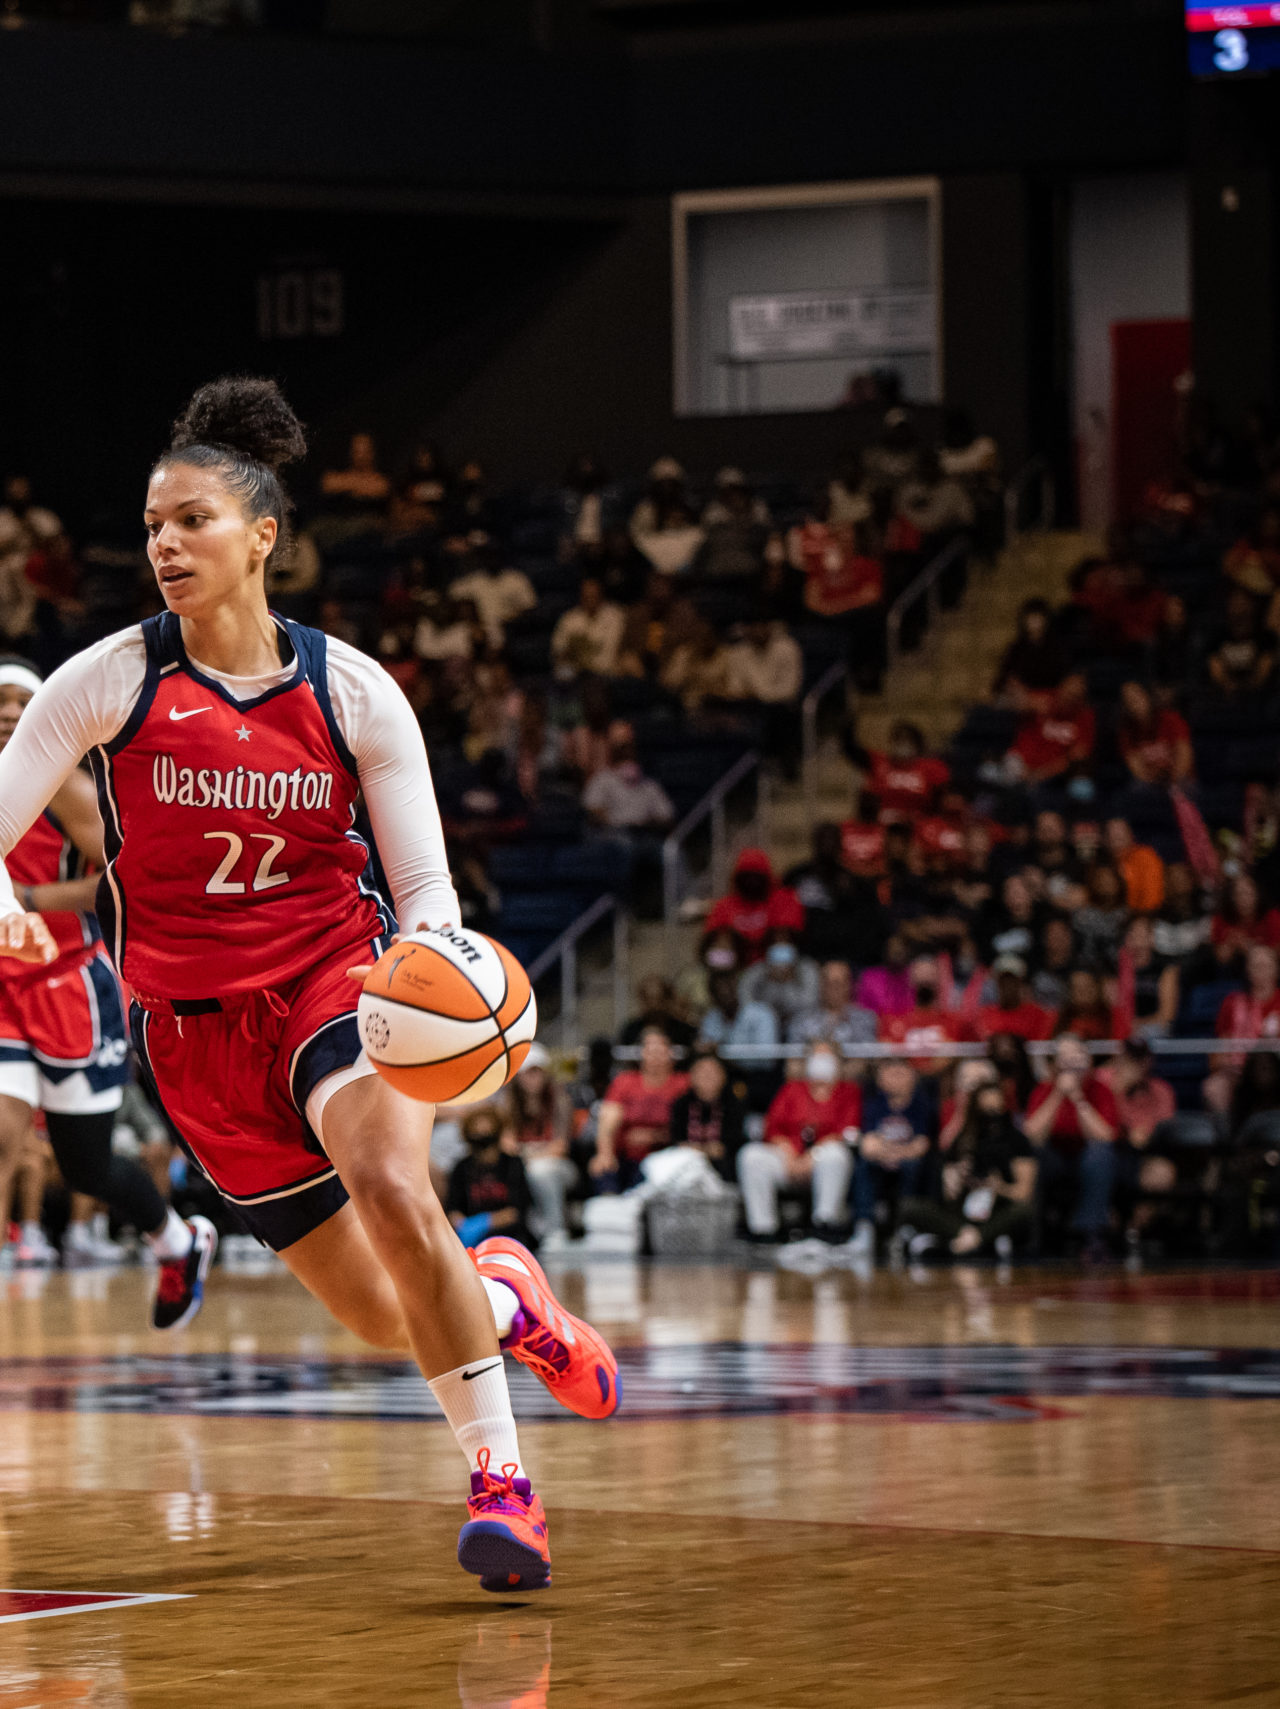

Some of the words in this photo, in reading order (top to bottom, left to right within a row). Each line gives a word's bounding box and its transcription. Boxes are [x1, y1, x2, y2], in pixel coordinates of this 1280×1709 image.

[1213, 28, 1249, 72] 3
[258, 272, 343, 338] 109
[152, 752, 334, 820] Washington
[203, 830, 290, 894] 22
[431, 927, 482, 964] son
